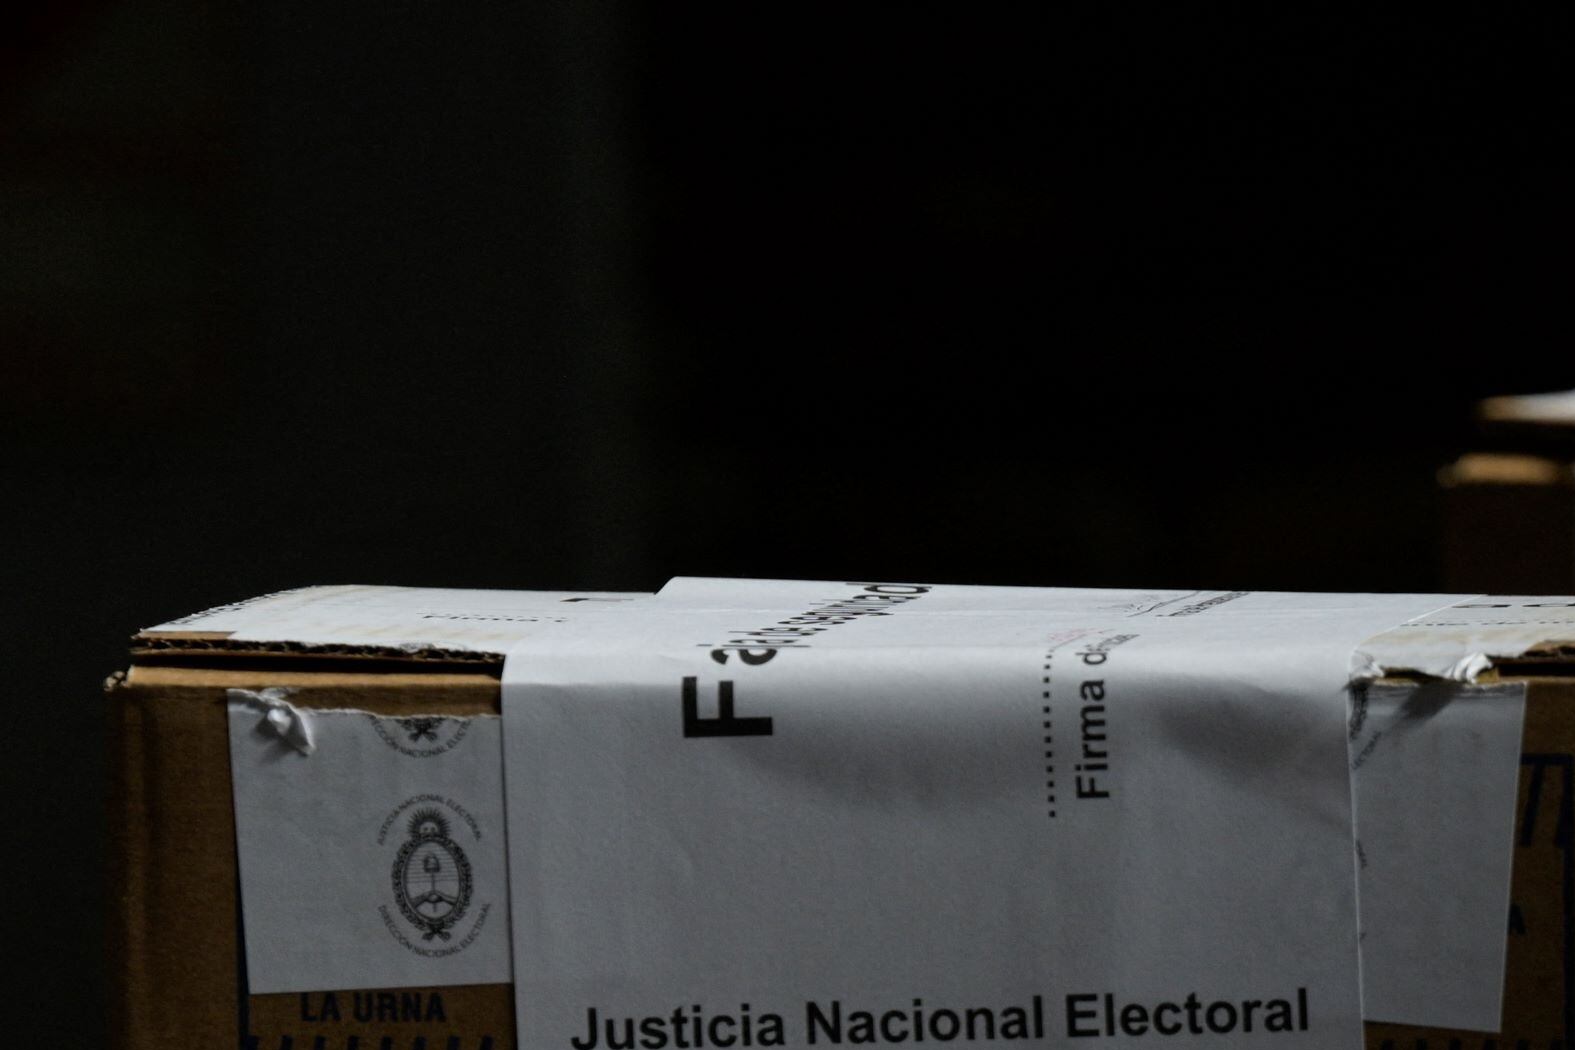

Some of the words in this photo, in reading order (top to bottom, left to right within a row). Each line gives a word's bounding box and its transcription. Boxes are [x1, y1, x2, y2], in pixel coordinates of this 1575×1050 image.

[1075, 679, 1110, 799] Firma
[302, 992, 340, 1022] LA
[353, 991, 446, 1022] URNA
[806, 995, 1044, 1045] Nacional
[1065, 987, 1309, 1038] Electoral
